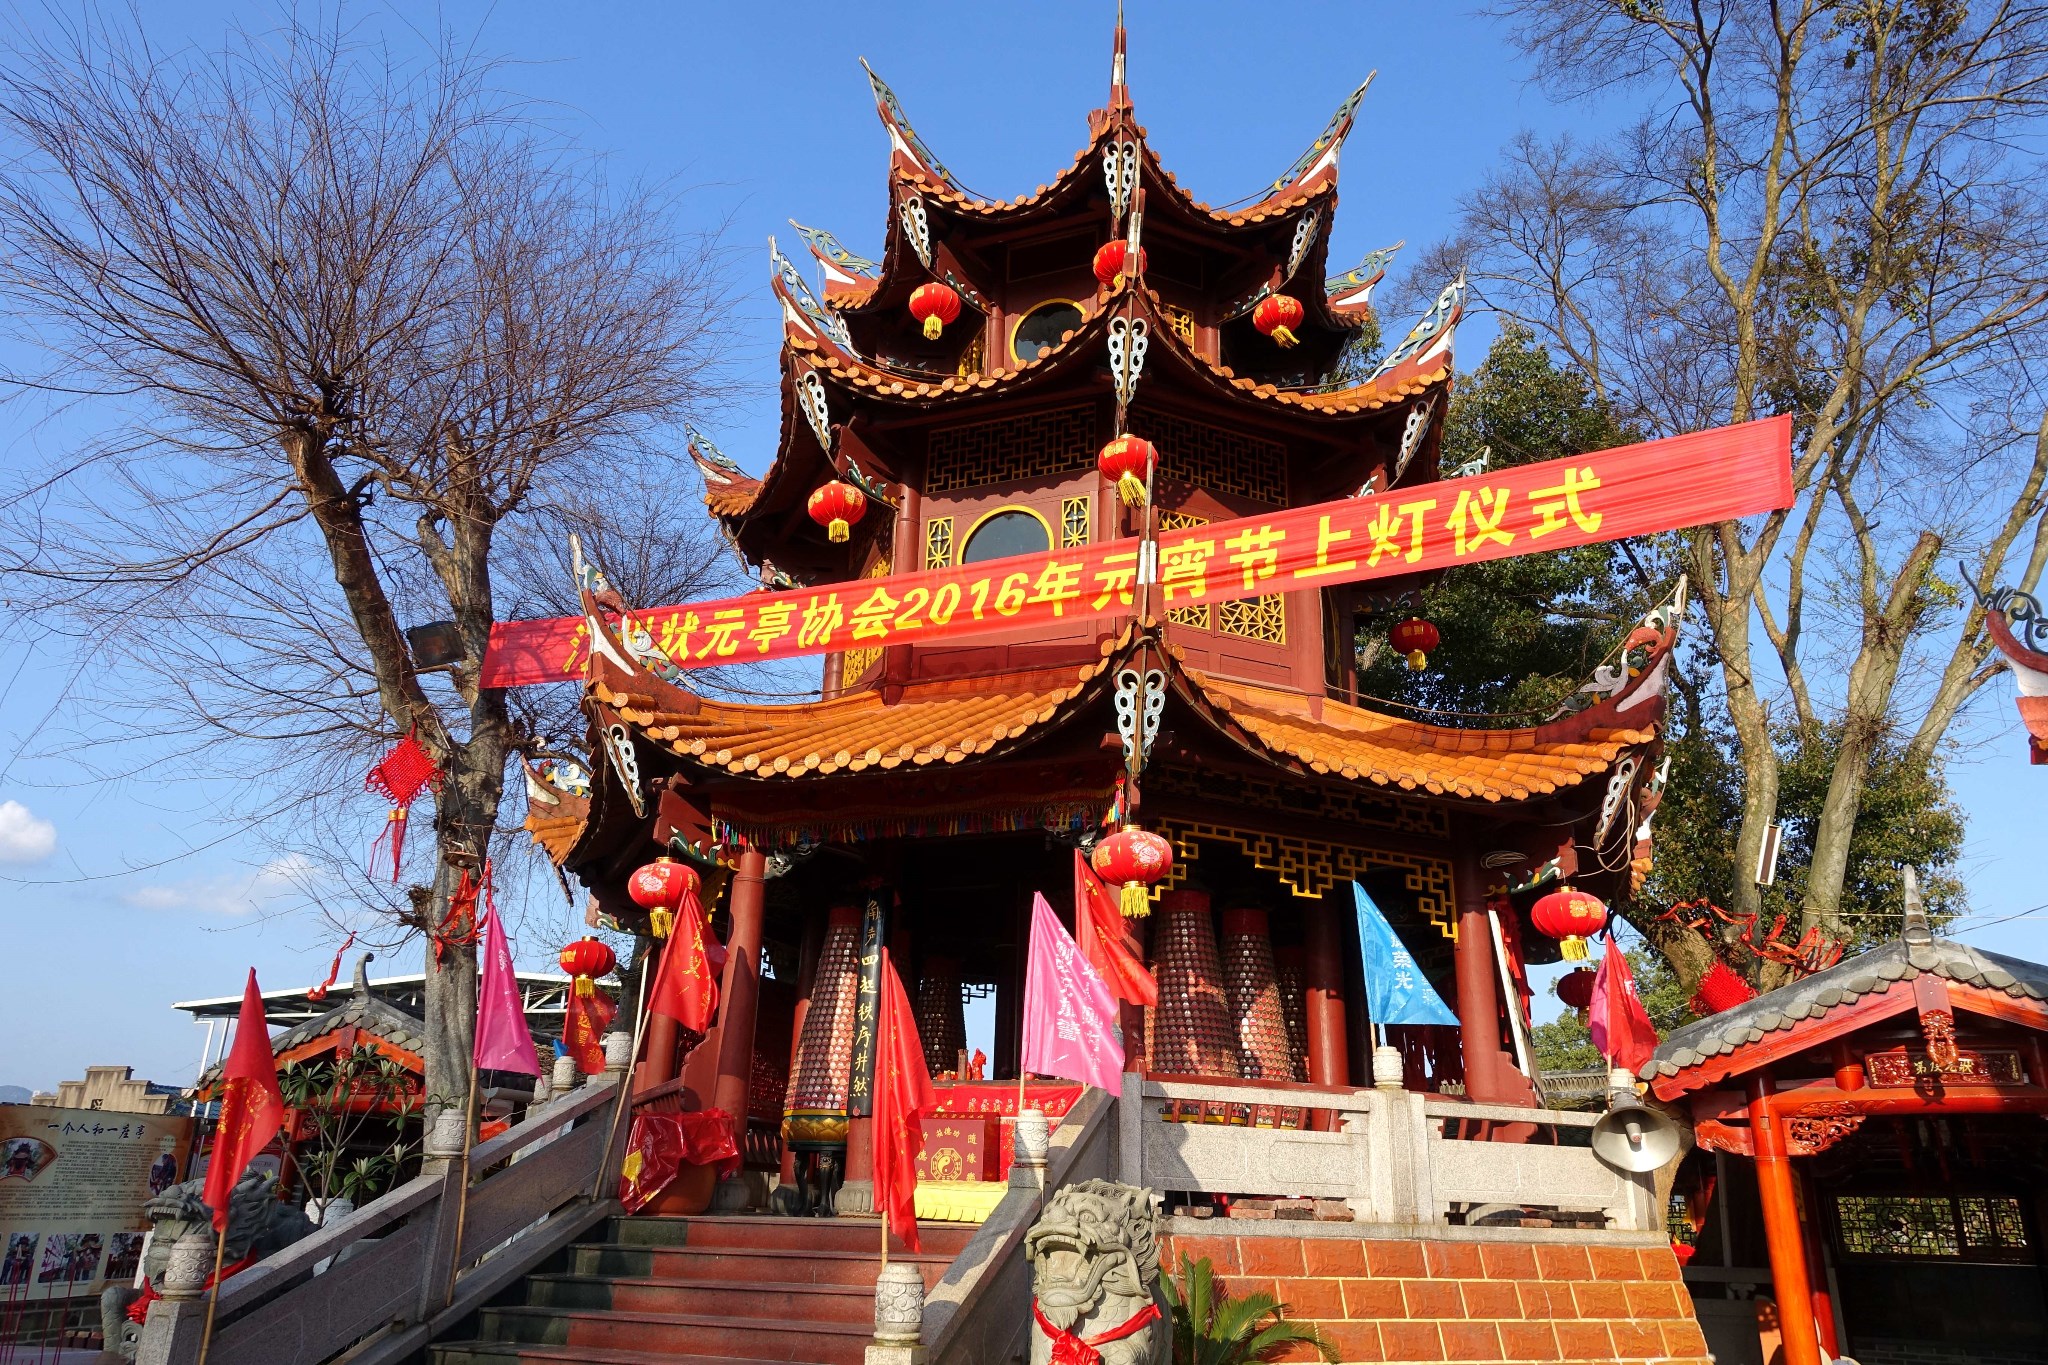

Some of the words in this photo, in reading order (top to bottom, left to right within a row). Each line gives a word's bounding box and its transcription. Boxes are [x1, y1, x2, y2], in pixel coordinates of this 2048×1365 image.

[562, 467, 1603, 673] 状元亭协会2016年元宵节上灯仪式
[47, 1121, 146, 1140] 一个人和一座亭
